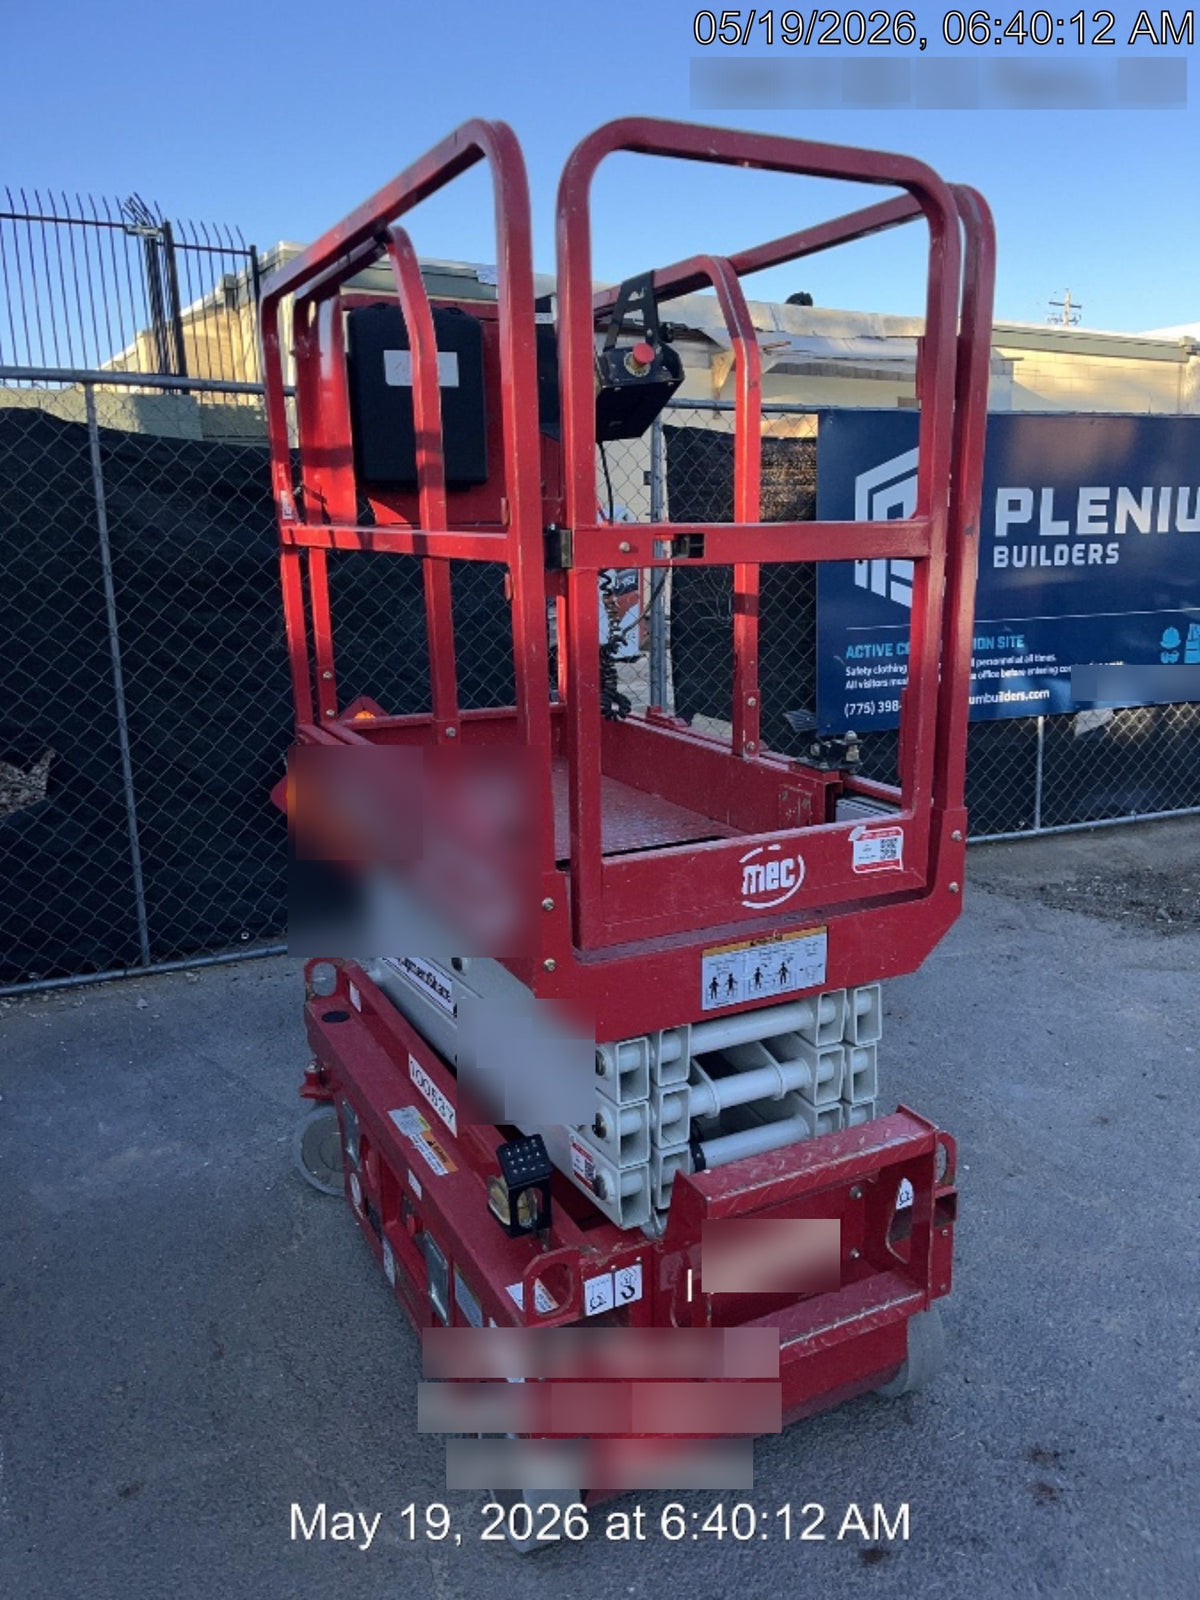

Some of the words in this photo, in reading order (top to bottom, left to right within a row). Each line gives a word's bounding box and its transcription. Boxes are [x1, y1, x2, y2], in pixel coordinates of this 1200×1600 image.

[993, 542, 1120, 568] BUILDERS
[846, 643, 893, 659] ACTIVE
[997, 635, 1025, 648] SITE
[845, 666, 872, 676] Safety
[873, 663, 907, 675] clothing
[858, 679, 888, 688] visitors
[978, 669, 1000, 680] office
[844, 700, 876, 718] (775)
